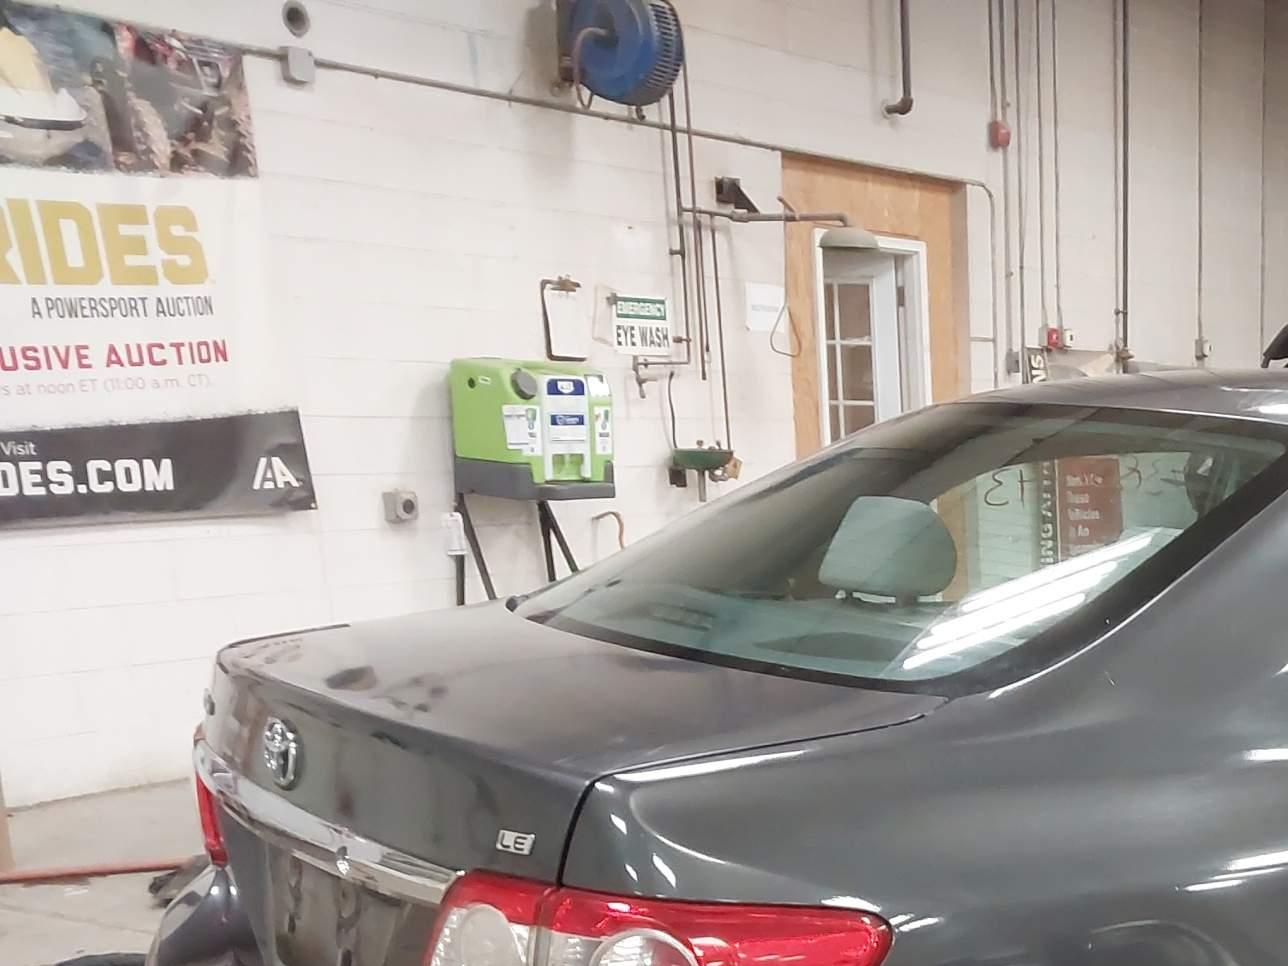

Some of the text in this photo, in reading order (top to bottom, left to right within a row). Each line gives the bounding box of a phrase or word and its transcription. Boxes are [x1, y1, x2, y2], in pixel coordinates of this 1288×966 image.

[31, 295, 214, 319] A POWERSPORT AUCTION
[616, 325, 670, 347] EYE WASH
[105, 339, 230, 368] AUCTION
[1, 441, 37, 456] Visit
[499, 831, 531, 853] LE
